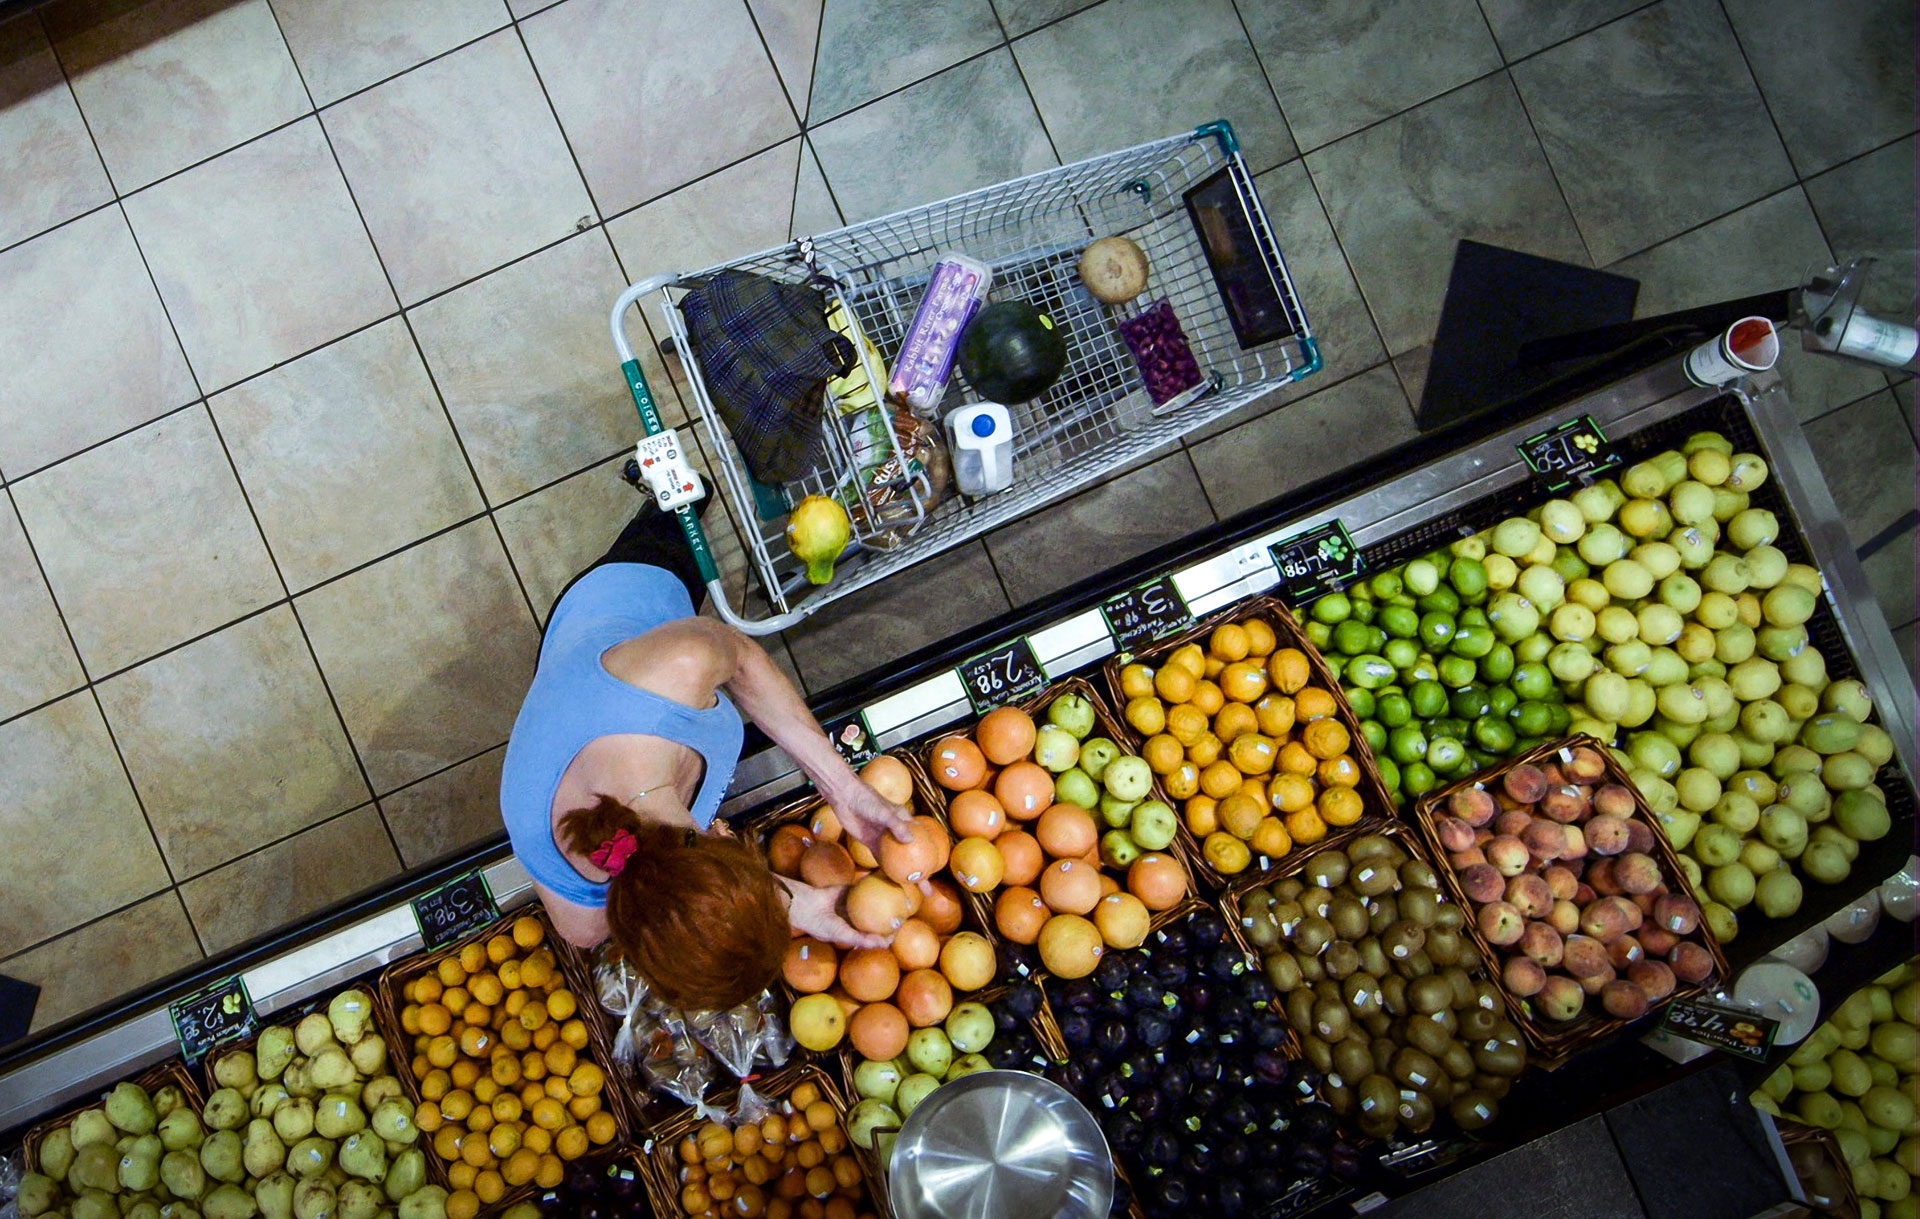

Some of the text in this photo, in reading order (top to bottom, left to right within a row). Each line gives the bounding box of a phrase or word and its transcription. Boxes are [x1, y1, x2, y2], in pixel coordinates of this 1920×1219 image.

[904, 276, 950, 371] Rabbit River Farms
